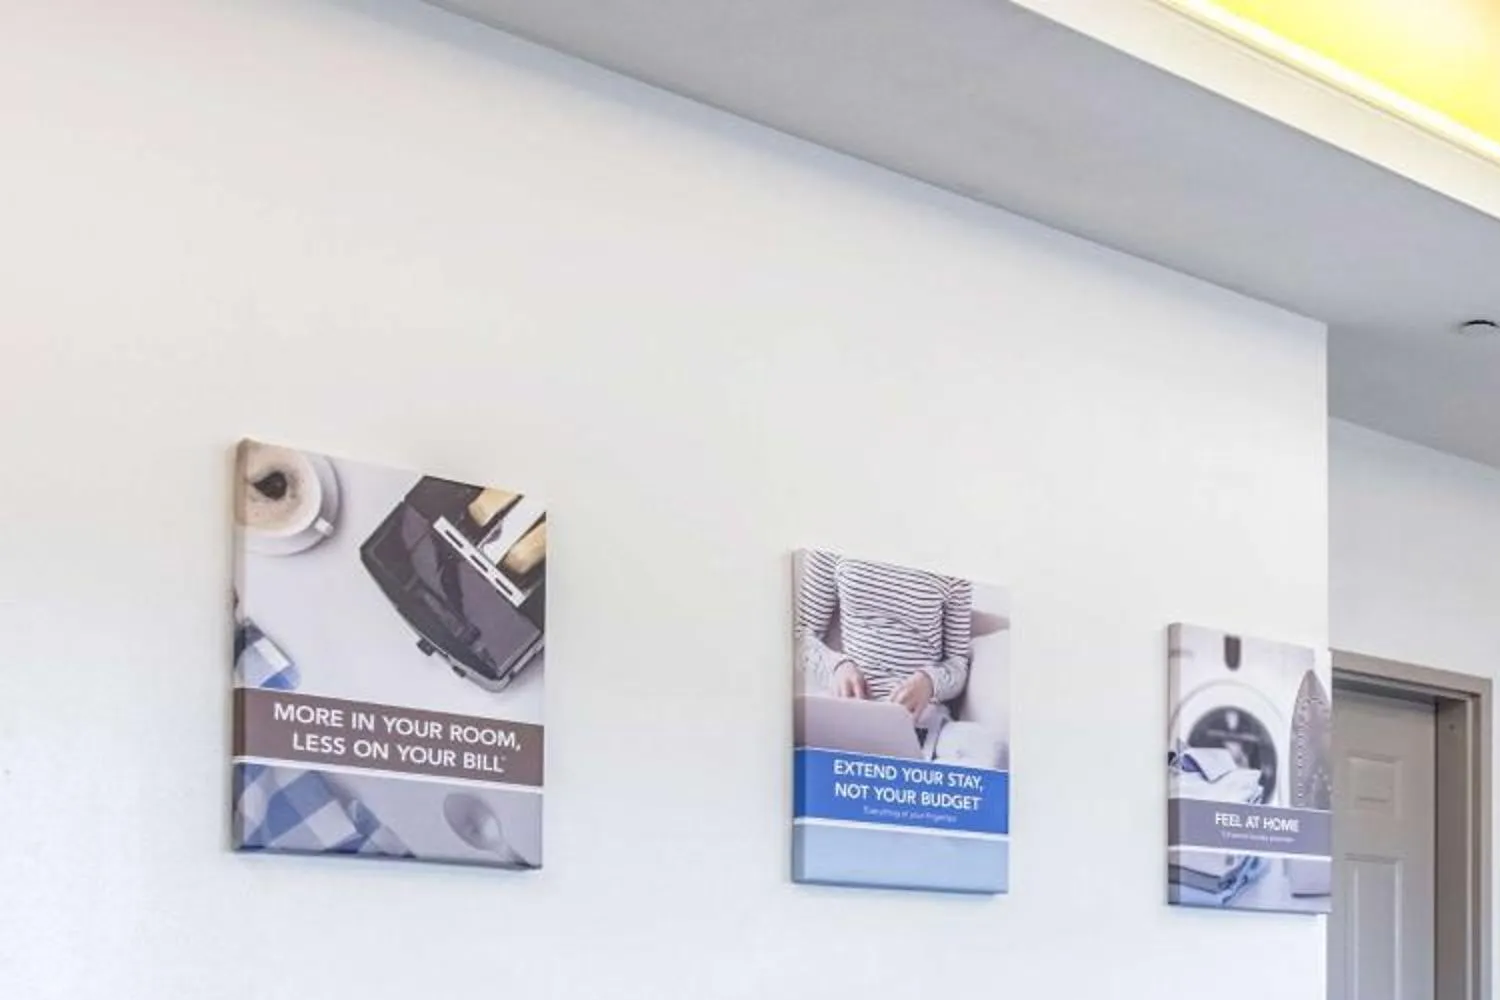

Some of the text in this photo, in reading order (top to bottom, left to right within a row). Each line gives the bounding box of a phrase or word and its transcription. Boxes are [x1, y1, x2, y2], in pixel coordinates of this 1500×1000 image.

[274, 702, 521, 752] MORE IN YOUR ROOM,
[293, 732, 346, 756] LESS
[353, 740, 389, 760] ON
[396, 744, 457, 768] YOUR
[833, 759, 983, 793] EXTEND YOUR STAY,
[835, 782, 982, 811] NOT YOUR BUDGET
[1215, 812, 1299, 833] FEEL AT HOME
